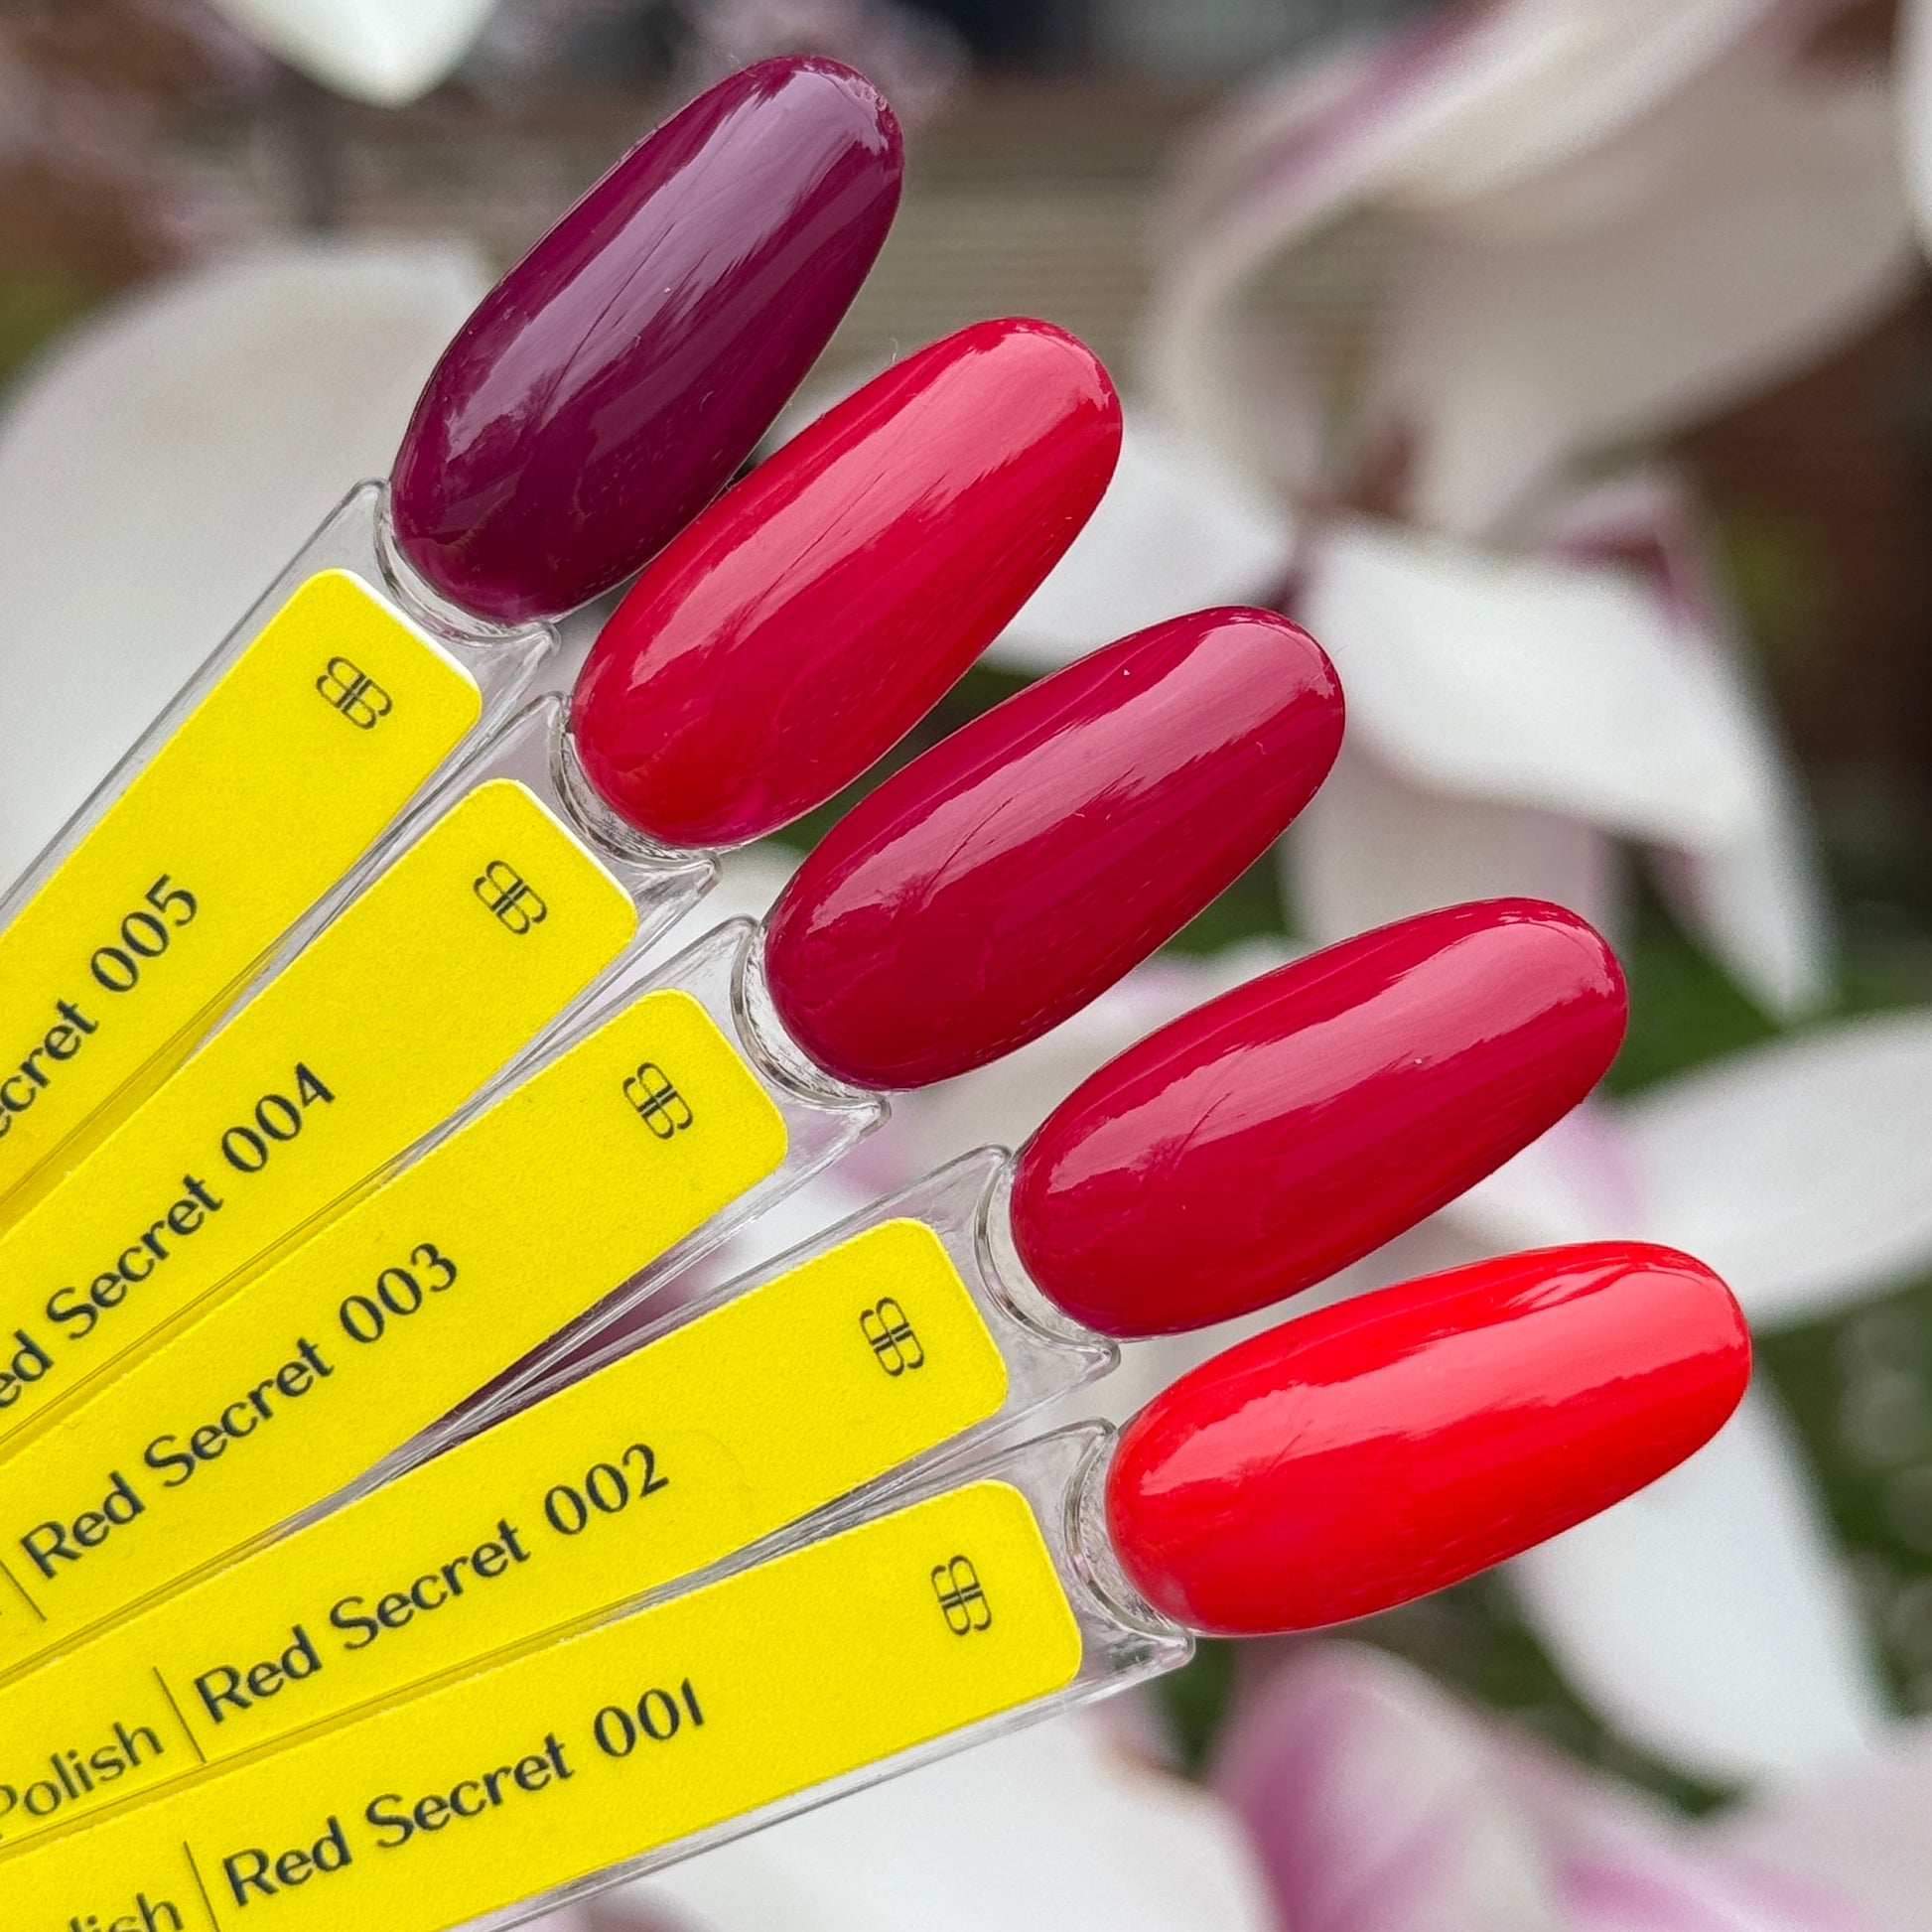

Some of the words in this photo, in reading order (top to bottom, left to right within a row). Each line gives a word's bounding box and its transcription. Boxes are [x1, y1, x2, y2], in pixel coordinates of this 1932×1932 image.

[90, 874, 198, 993] 005
[46, 1174, 224, 1339] Secret
[221, 1061, 337, 1173] 004
[20, 1470, 146, 1580] Red
[144, 1337, 335, 1487] Secret
[340, 1243, 458, 1344] 003
[194, 1624, 323, 1724] Red
[330, 1519, 531, 1650] Secret
[544, 1444, 670, 1536] 002
[223, 1816, 353, 1907] Red
[365, 1733, 574, 1849] Secret
[594, 1678, 705, 1758] 001
